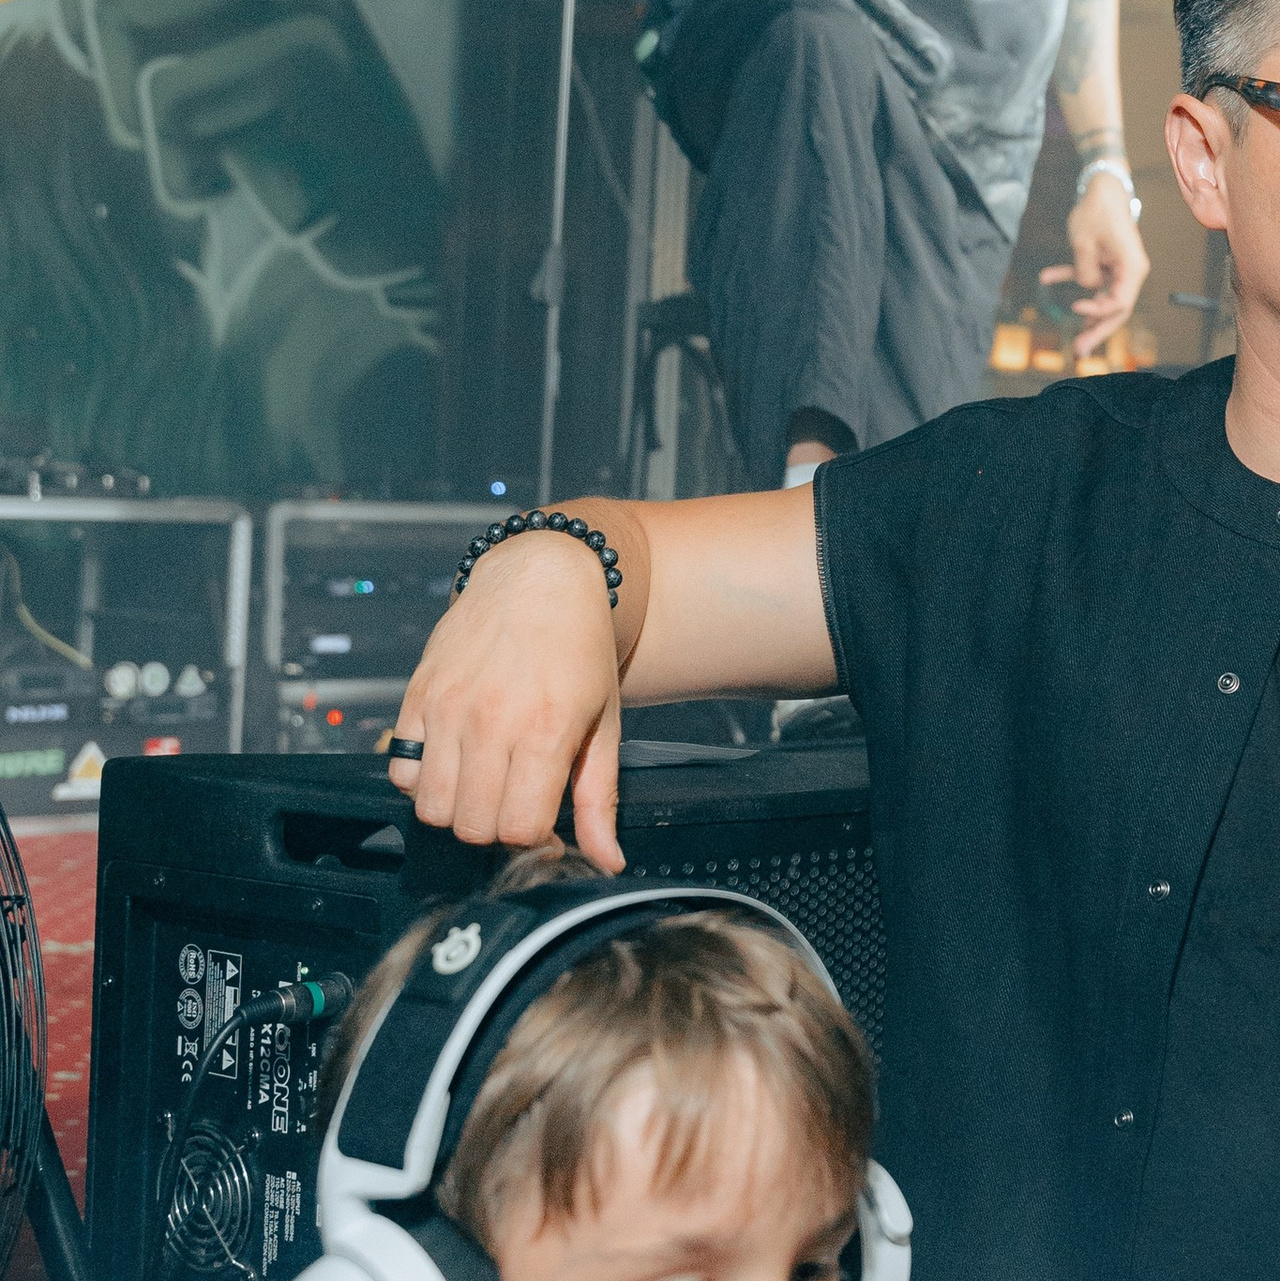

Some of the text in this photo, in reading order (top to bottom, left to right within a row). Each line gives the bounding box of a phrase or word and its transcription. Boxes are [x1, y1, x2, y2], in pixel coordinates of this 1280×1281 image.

[188, 952, 197, 977] RoHS
[258, 1023, 273, 1105] X12CMA
[280, 1177, 286, 1189] AC
[296, 1180, 302, 1192] AC
